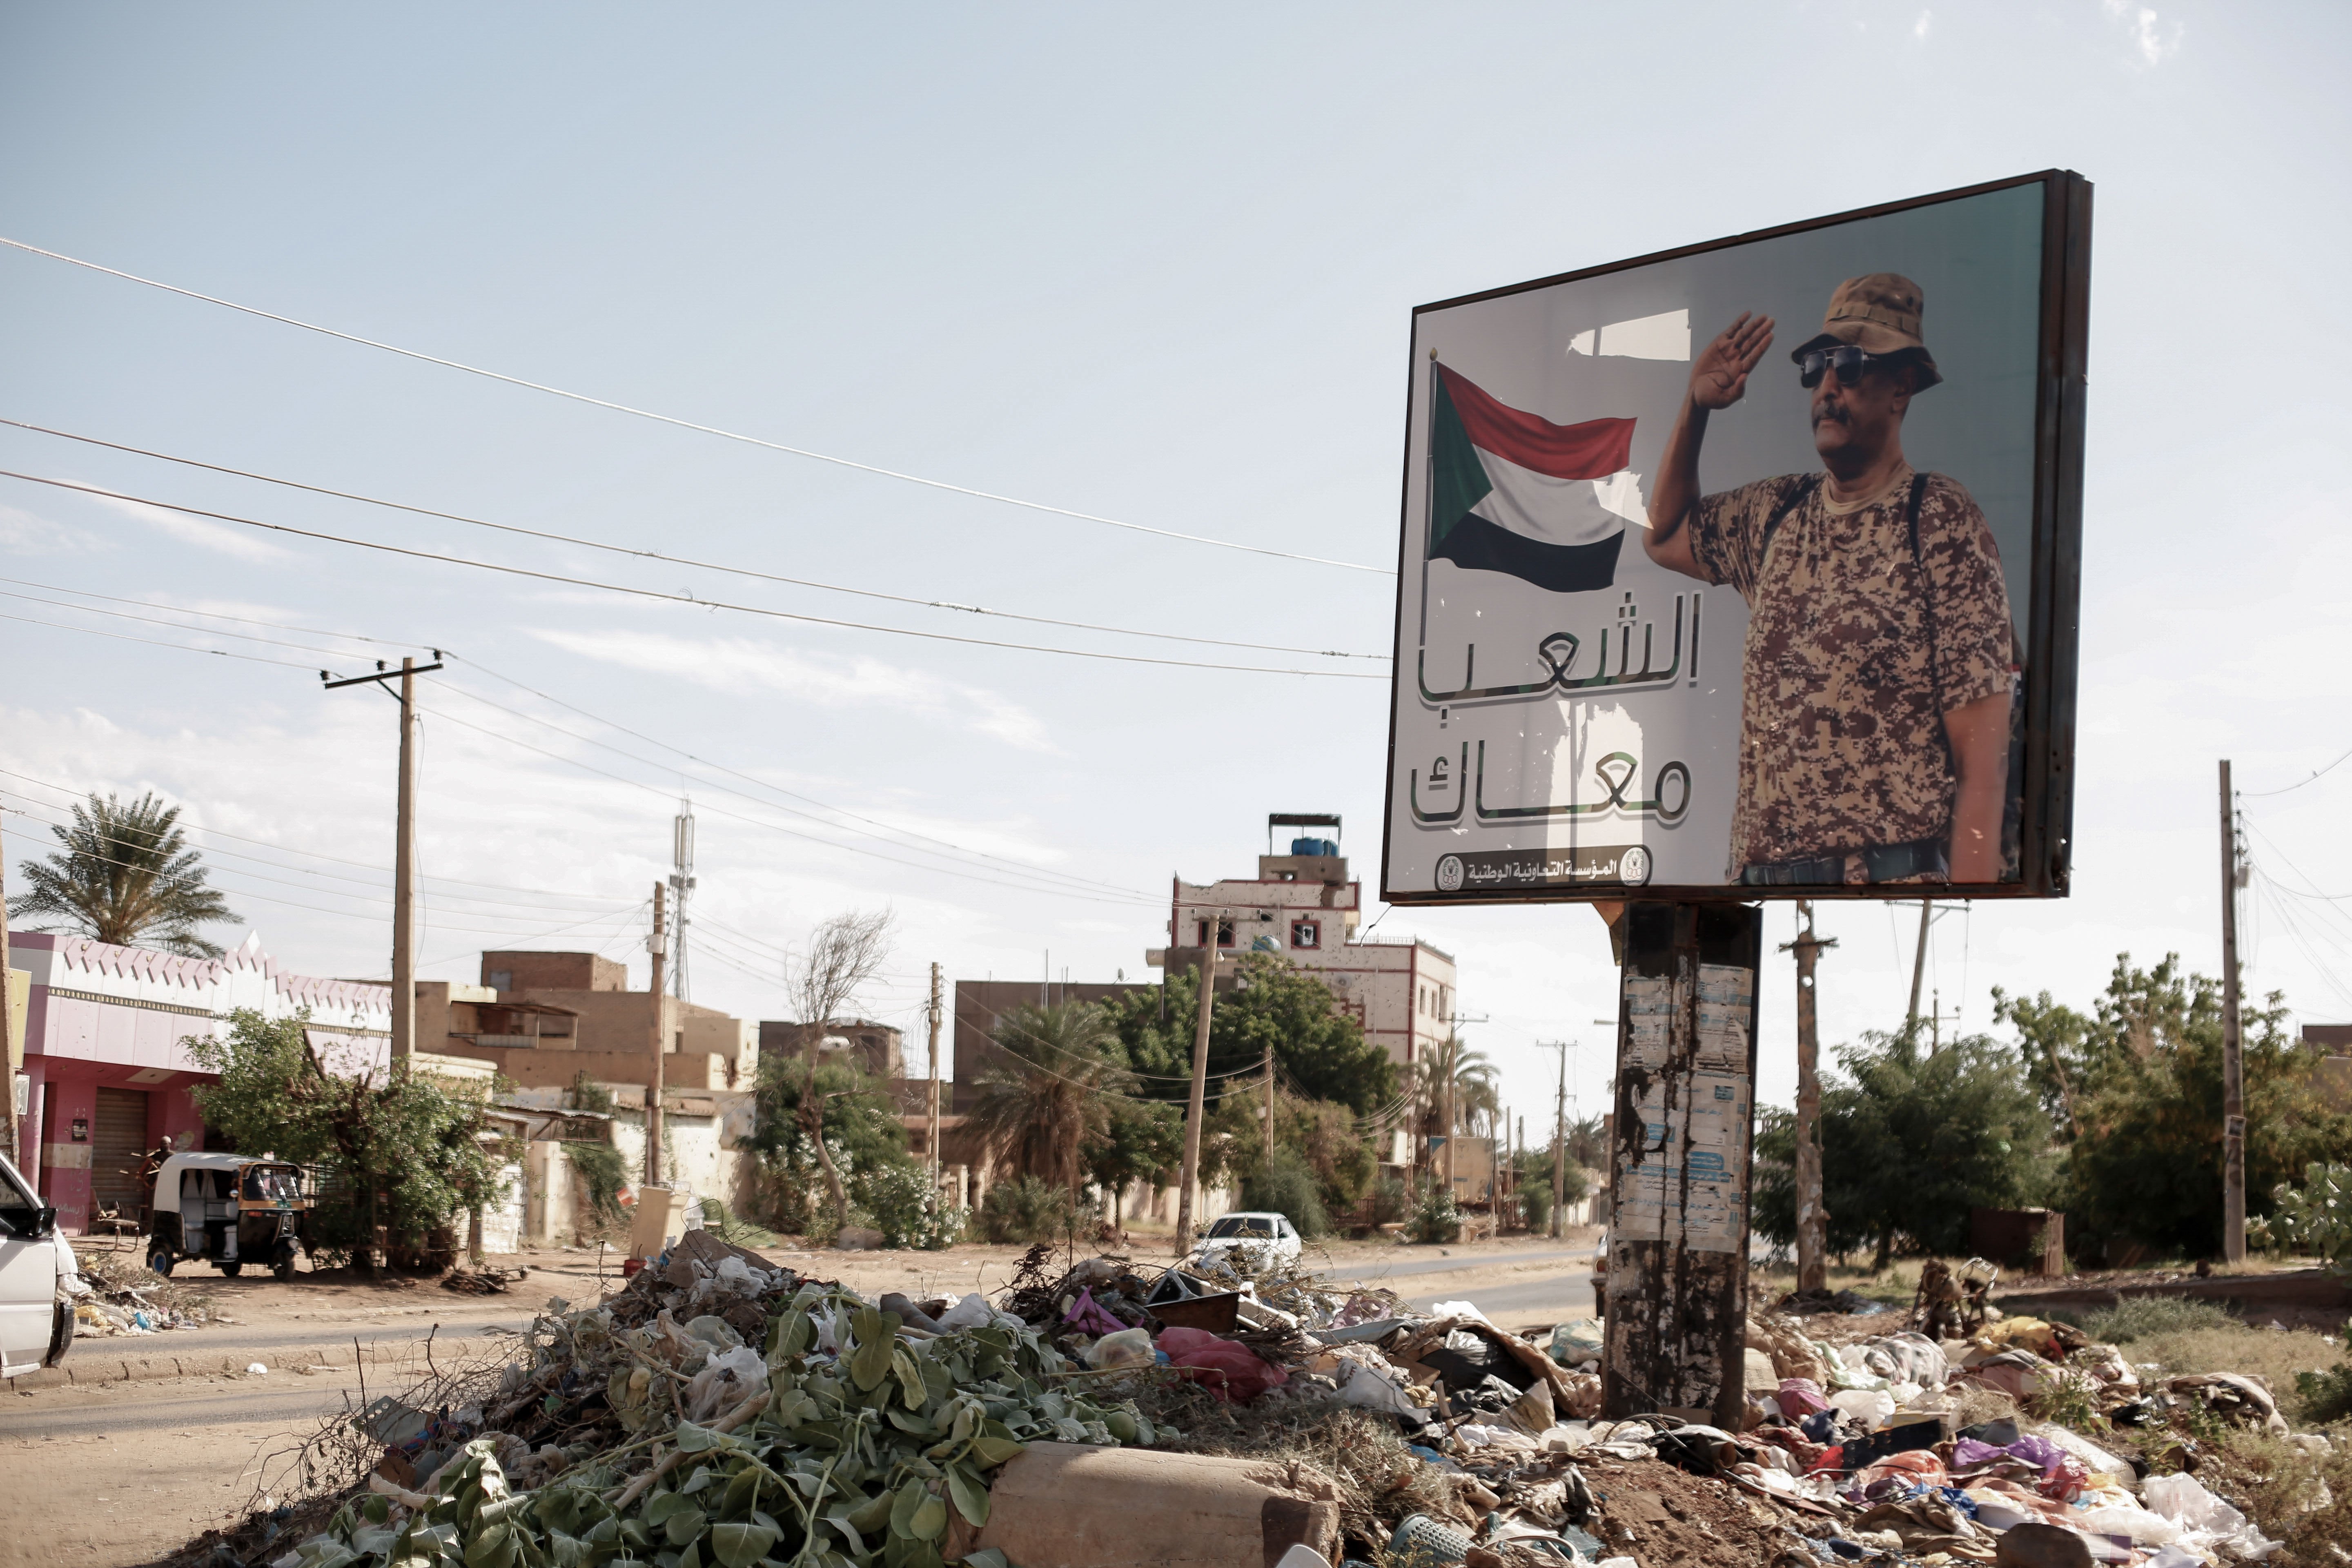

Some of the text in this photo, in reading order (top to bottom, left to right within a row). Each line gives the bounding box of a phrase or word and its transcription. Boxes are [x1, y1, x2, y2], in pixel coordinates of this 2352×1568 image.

[1419, 592, 1701, 720] الشعب
[1469, 859, 1617, 883] المؤسسة التعاونية الوطنية
